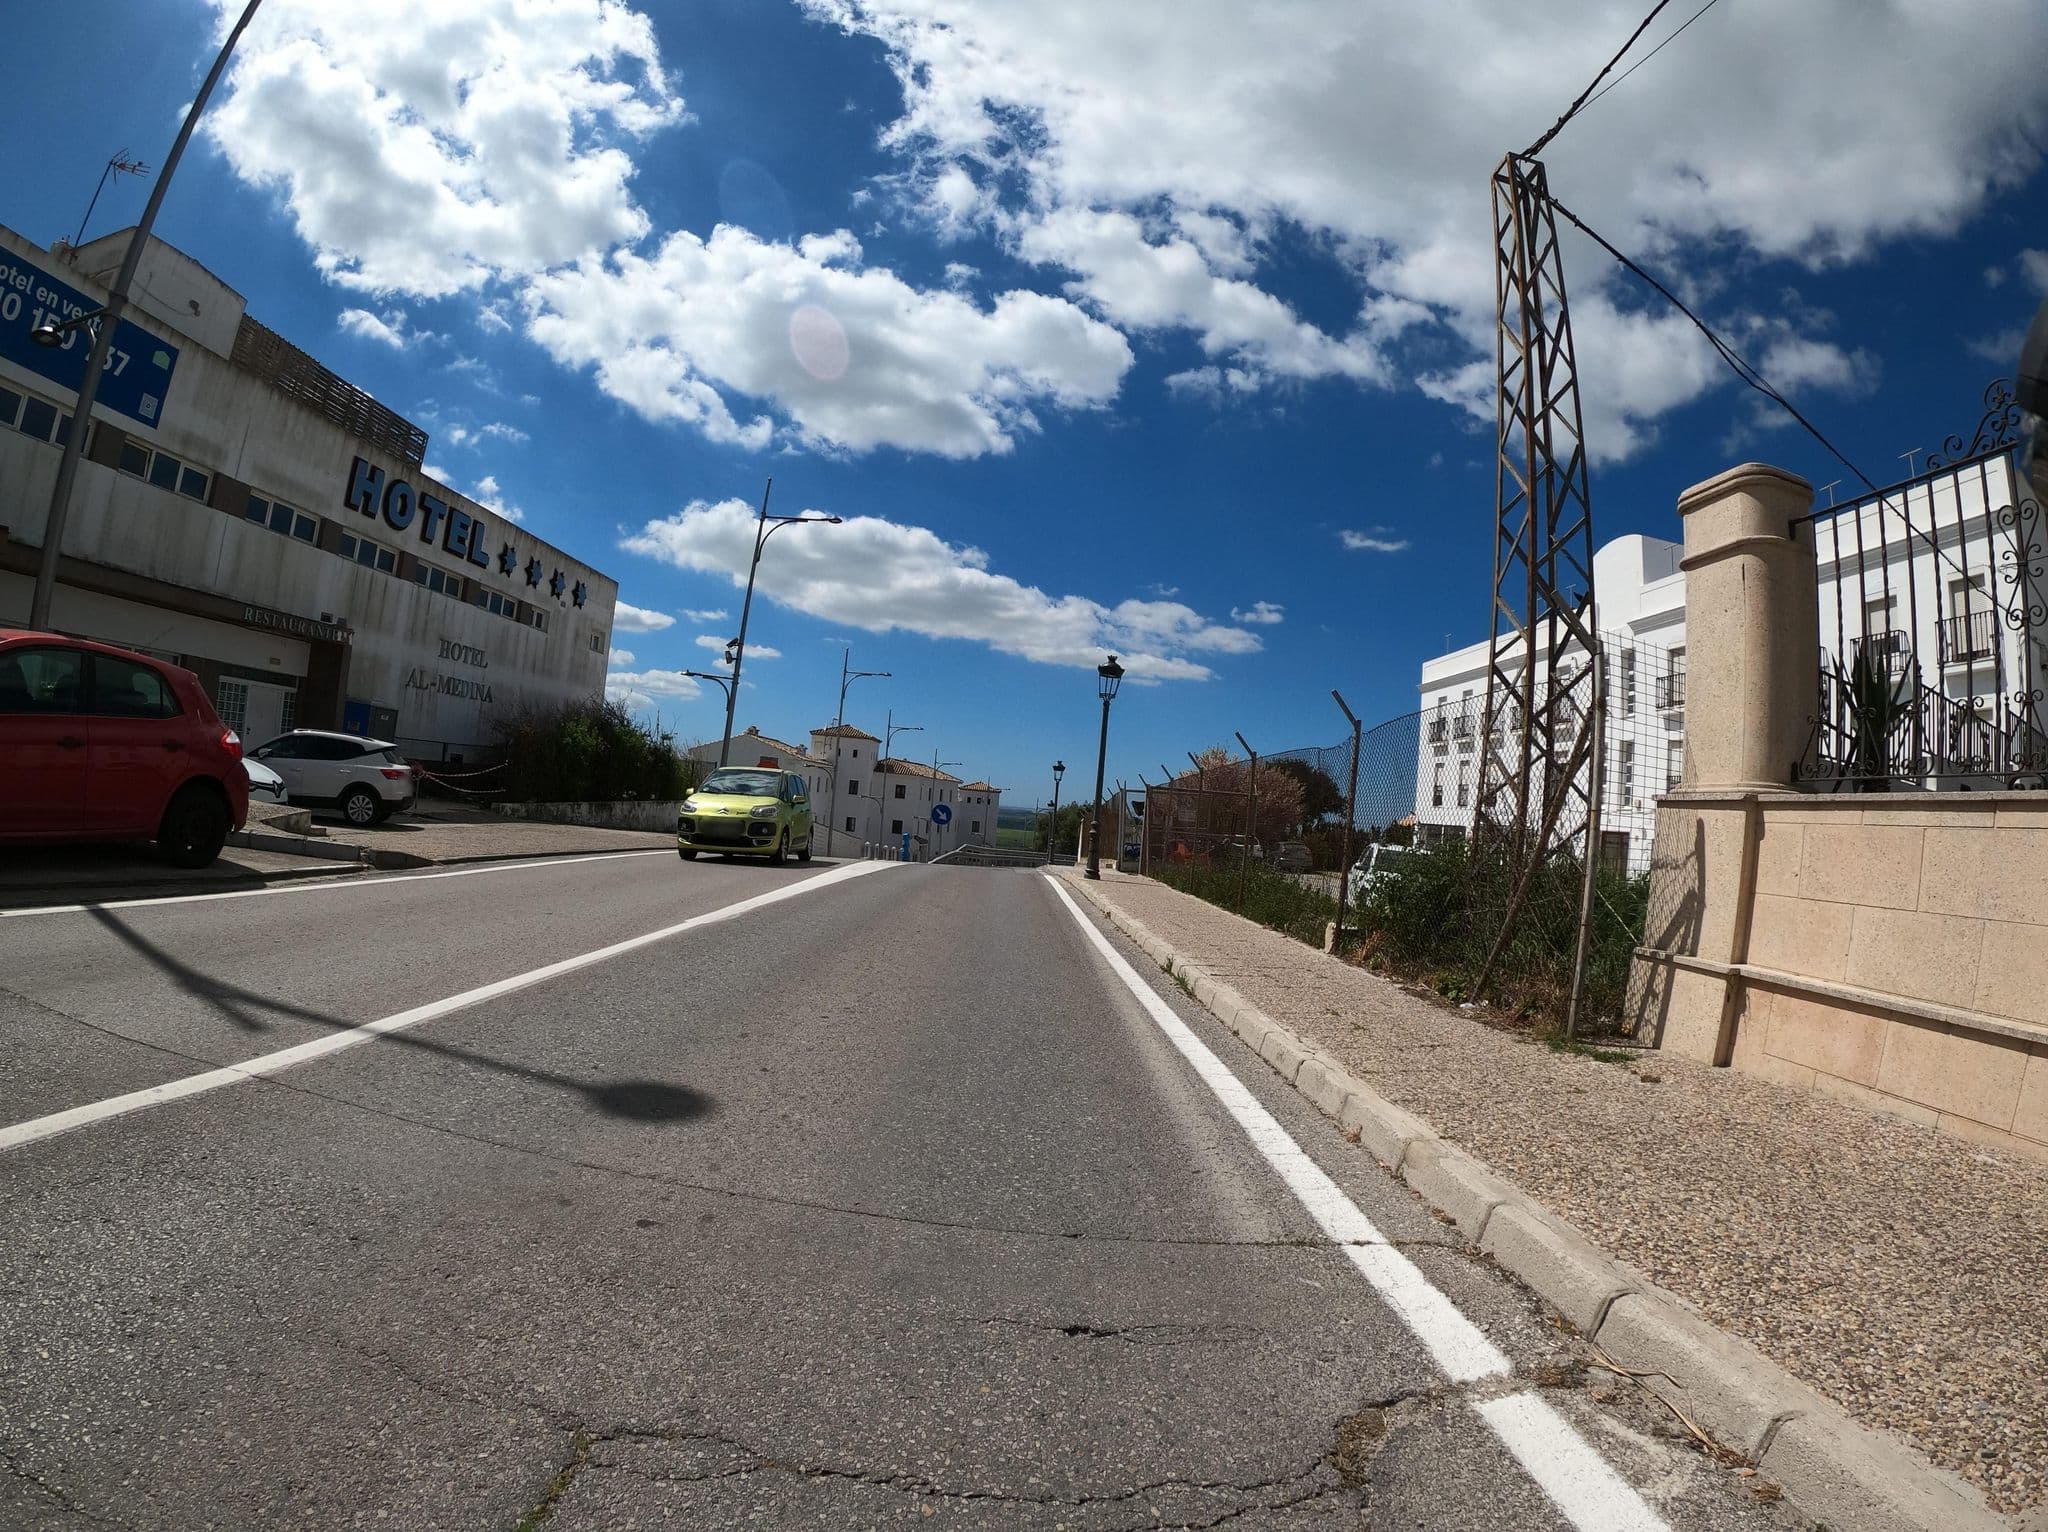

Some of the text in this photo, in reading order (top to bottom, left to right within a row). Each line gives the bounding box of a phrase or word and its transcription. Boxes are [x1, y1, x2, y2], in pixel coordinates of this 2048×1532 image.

[36, 287, 59, 309] en
[344, 456, 490, 569] HOTEL
[438, 638, 488, 669] HOTEL
[405, 668, 493, 703] AL-MEDINA
